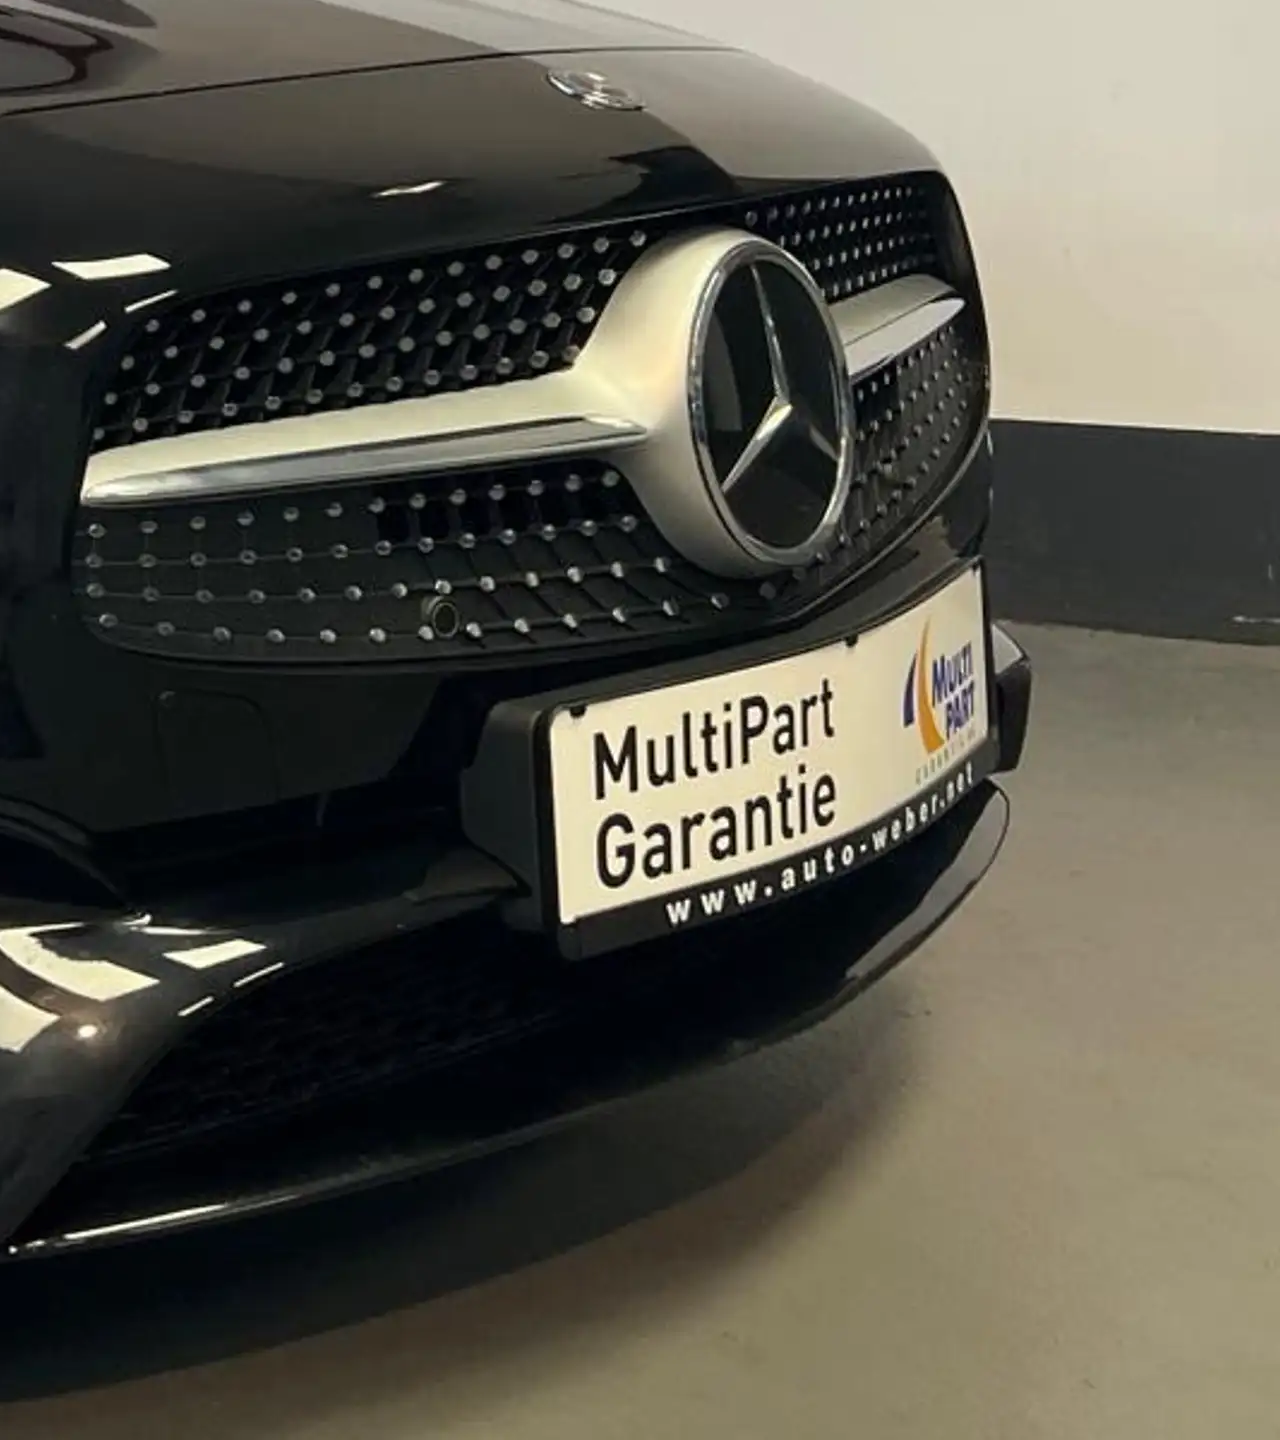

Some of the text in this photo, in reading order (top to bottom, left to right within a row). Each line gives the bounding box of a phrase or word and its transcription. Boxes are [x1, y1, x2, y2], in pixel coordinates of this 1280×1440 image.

[592, 678, 836, 801] MultiPart
[596, 764, 837, 888] Garantie
[665, 760, 975, 928] www.auto-weber.net
